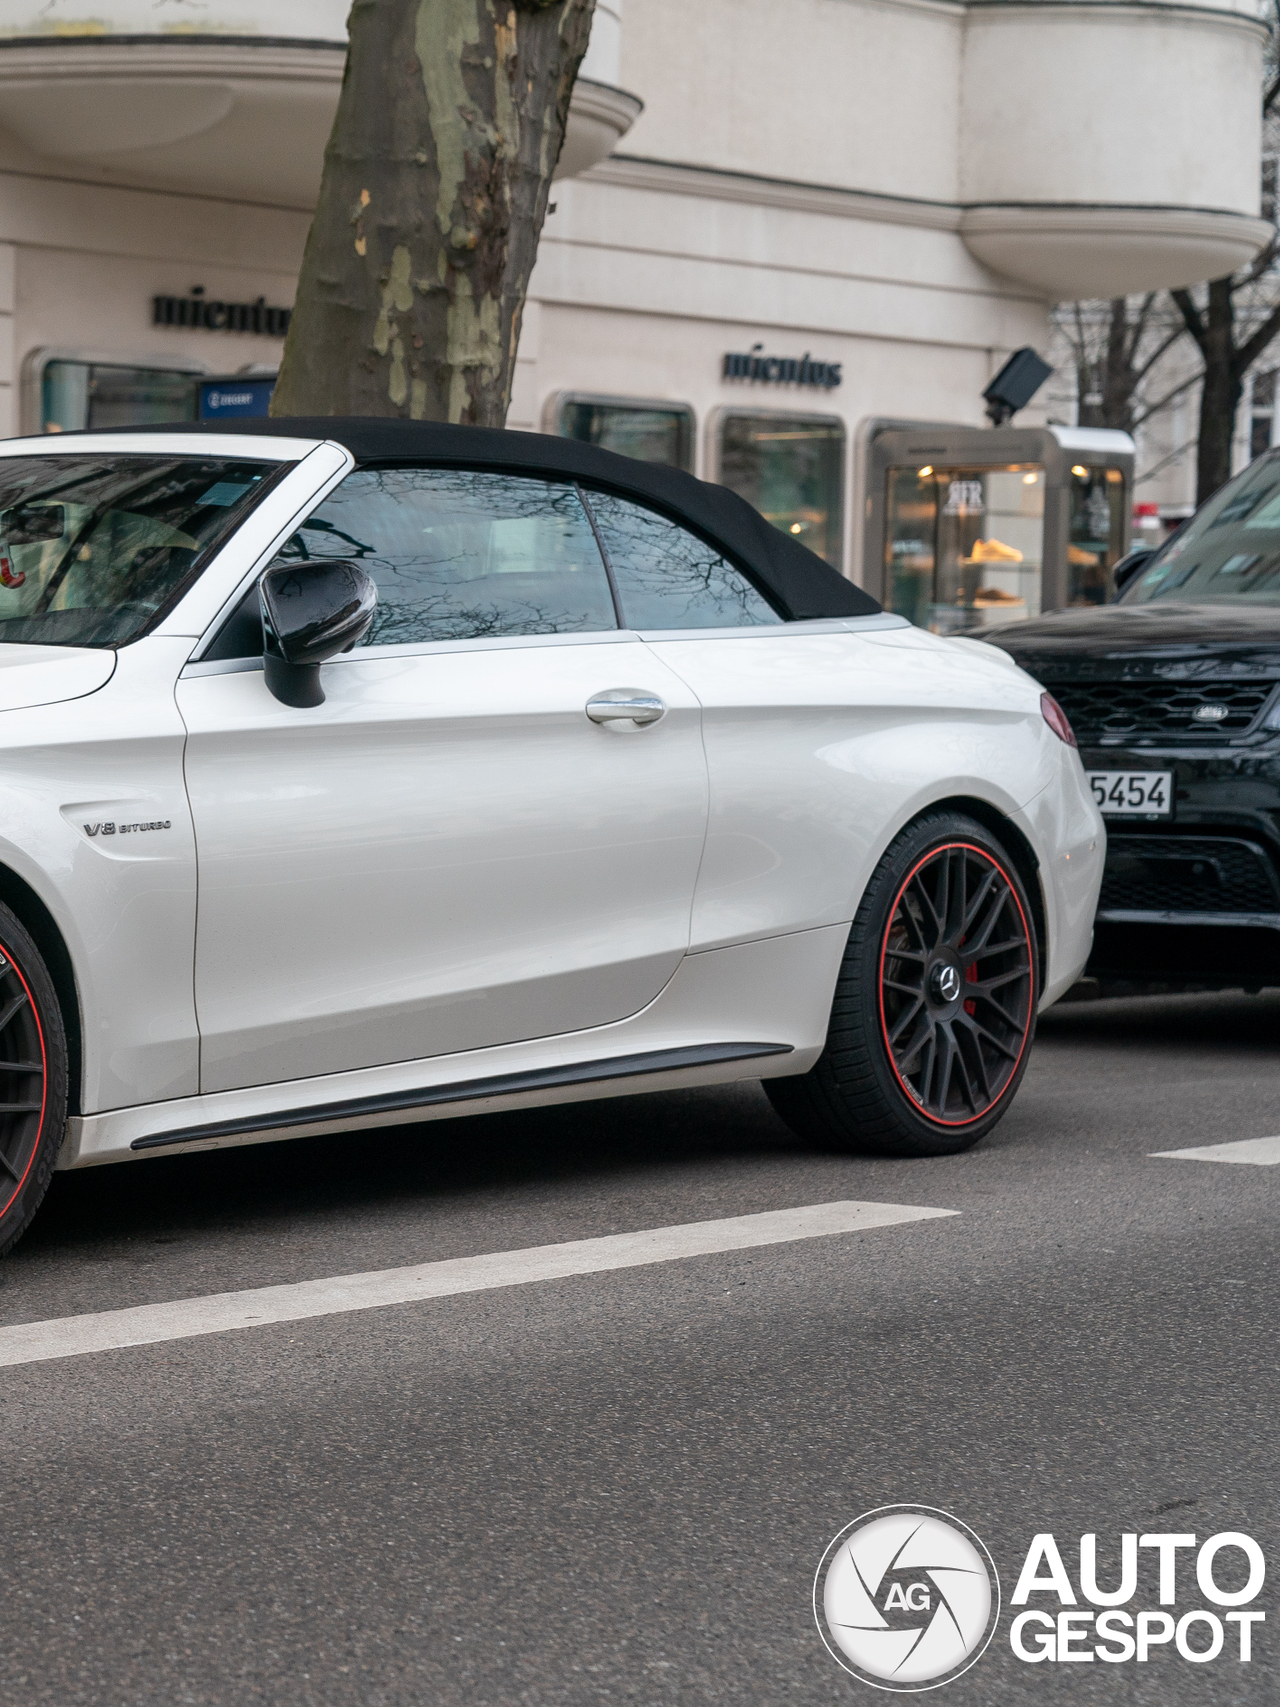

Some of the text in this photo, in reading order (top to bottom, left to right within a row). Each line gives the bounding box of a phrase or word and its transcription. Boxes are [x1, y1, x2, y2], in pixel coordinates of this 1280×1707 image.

[153, 286, 292, 336] mientu
[723, 343, 842, 387] mientus
[1091, 776, 1166, 808] 5454
[84, 820, 171, 836] V8 BITURBO
